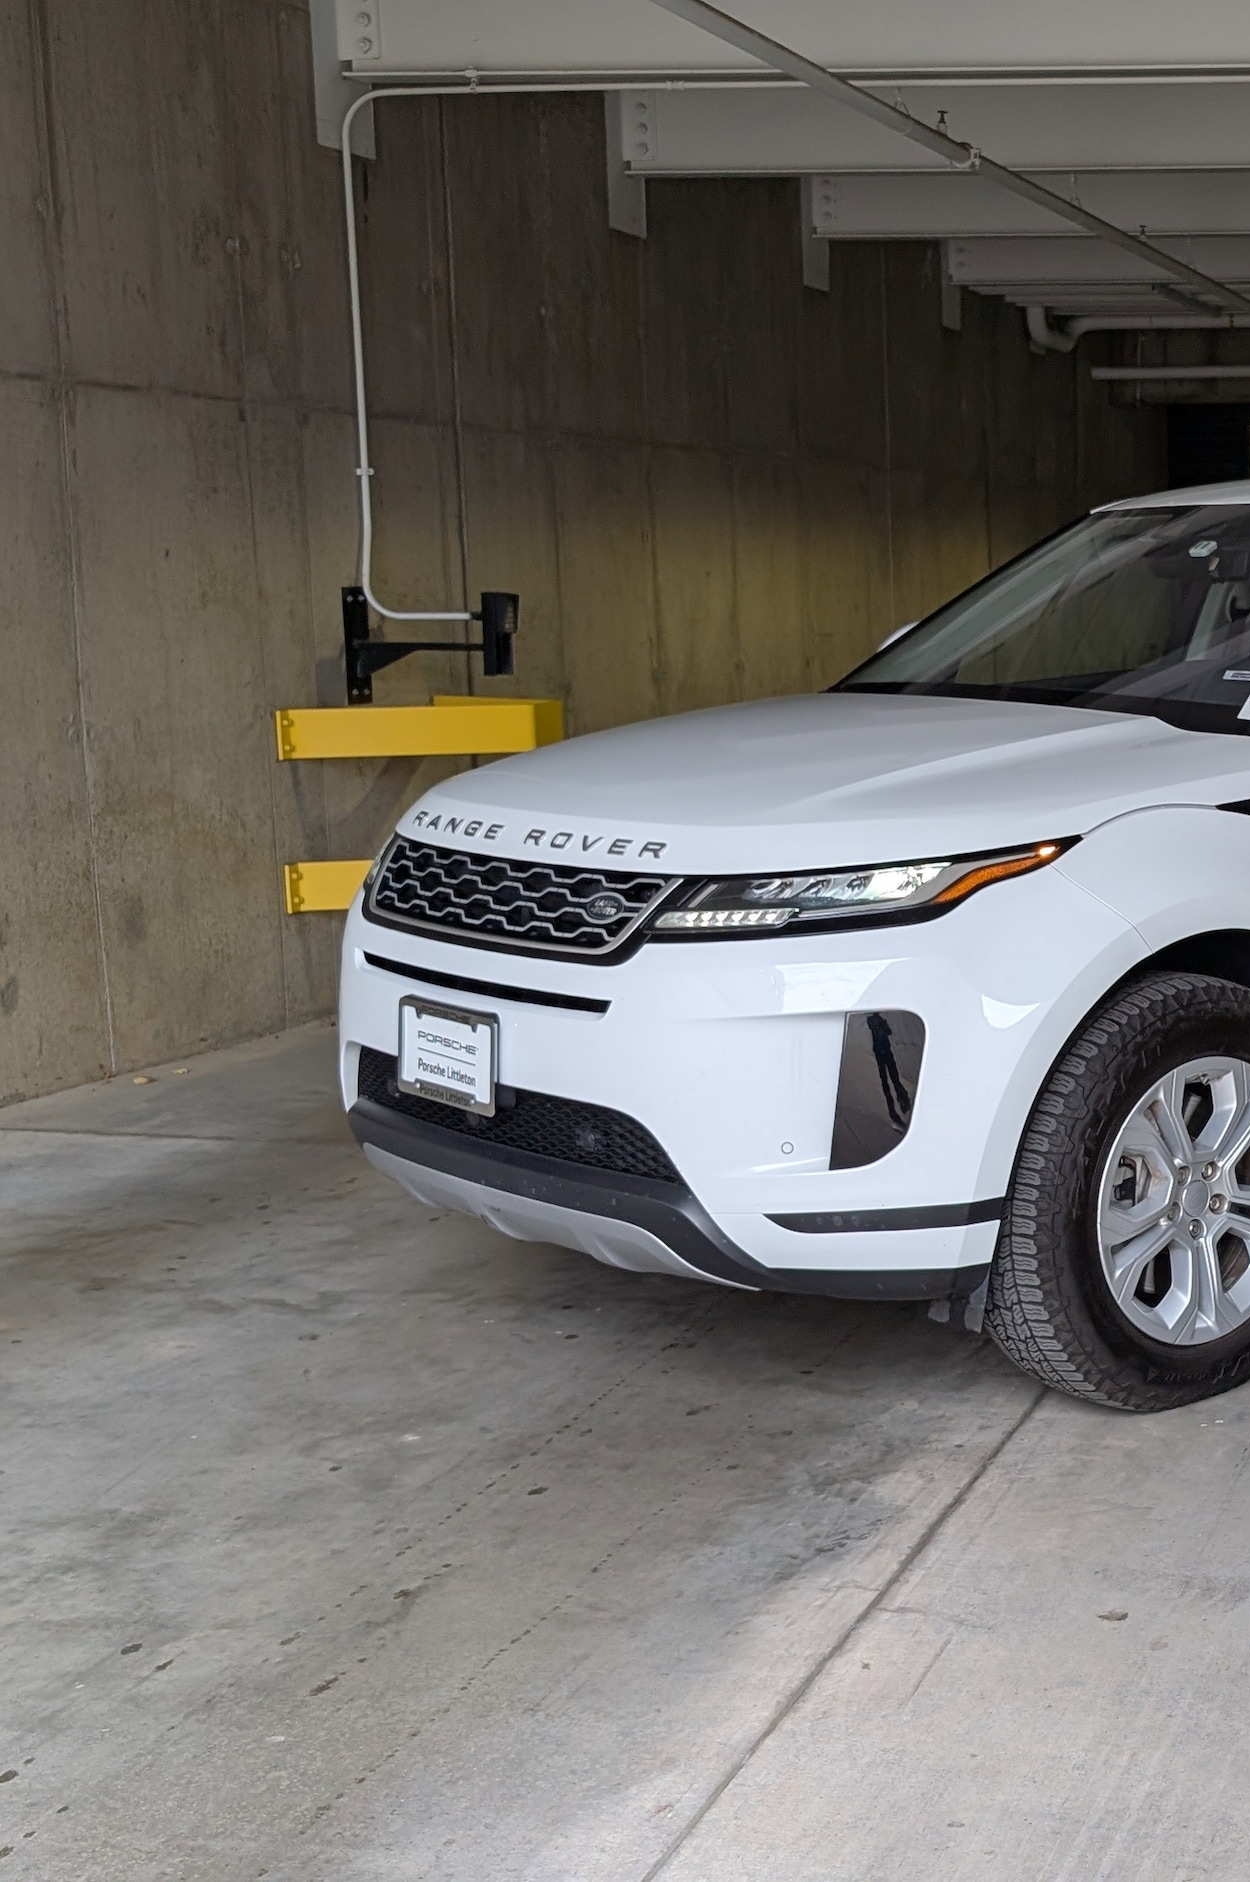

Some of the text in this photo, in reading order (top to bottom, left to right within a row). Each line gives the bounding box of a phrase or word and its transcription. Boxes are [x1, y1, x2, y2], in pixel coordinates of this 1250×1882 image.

[413, 810, 667, 859] RANGE ROVER
[419, 1005, 471, 1023] PORSCHE
[418, 1030, 477, 1056] PORSCHE
[418, 1057, 476, 1087] Porsche Littleton
[419, 1084, 445, 1099] Porsche
